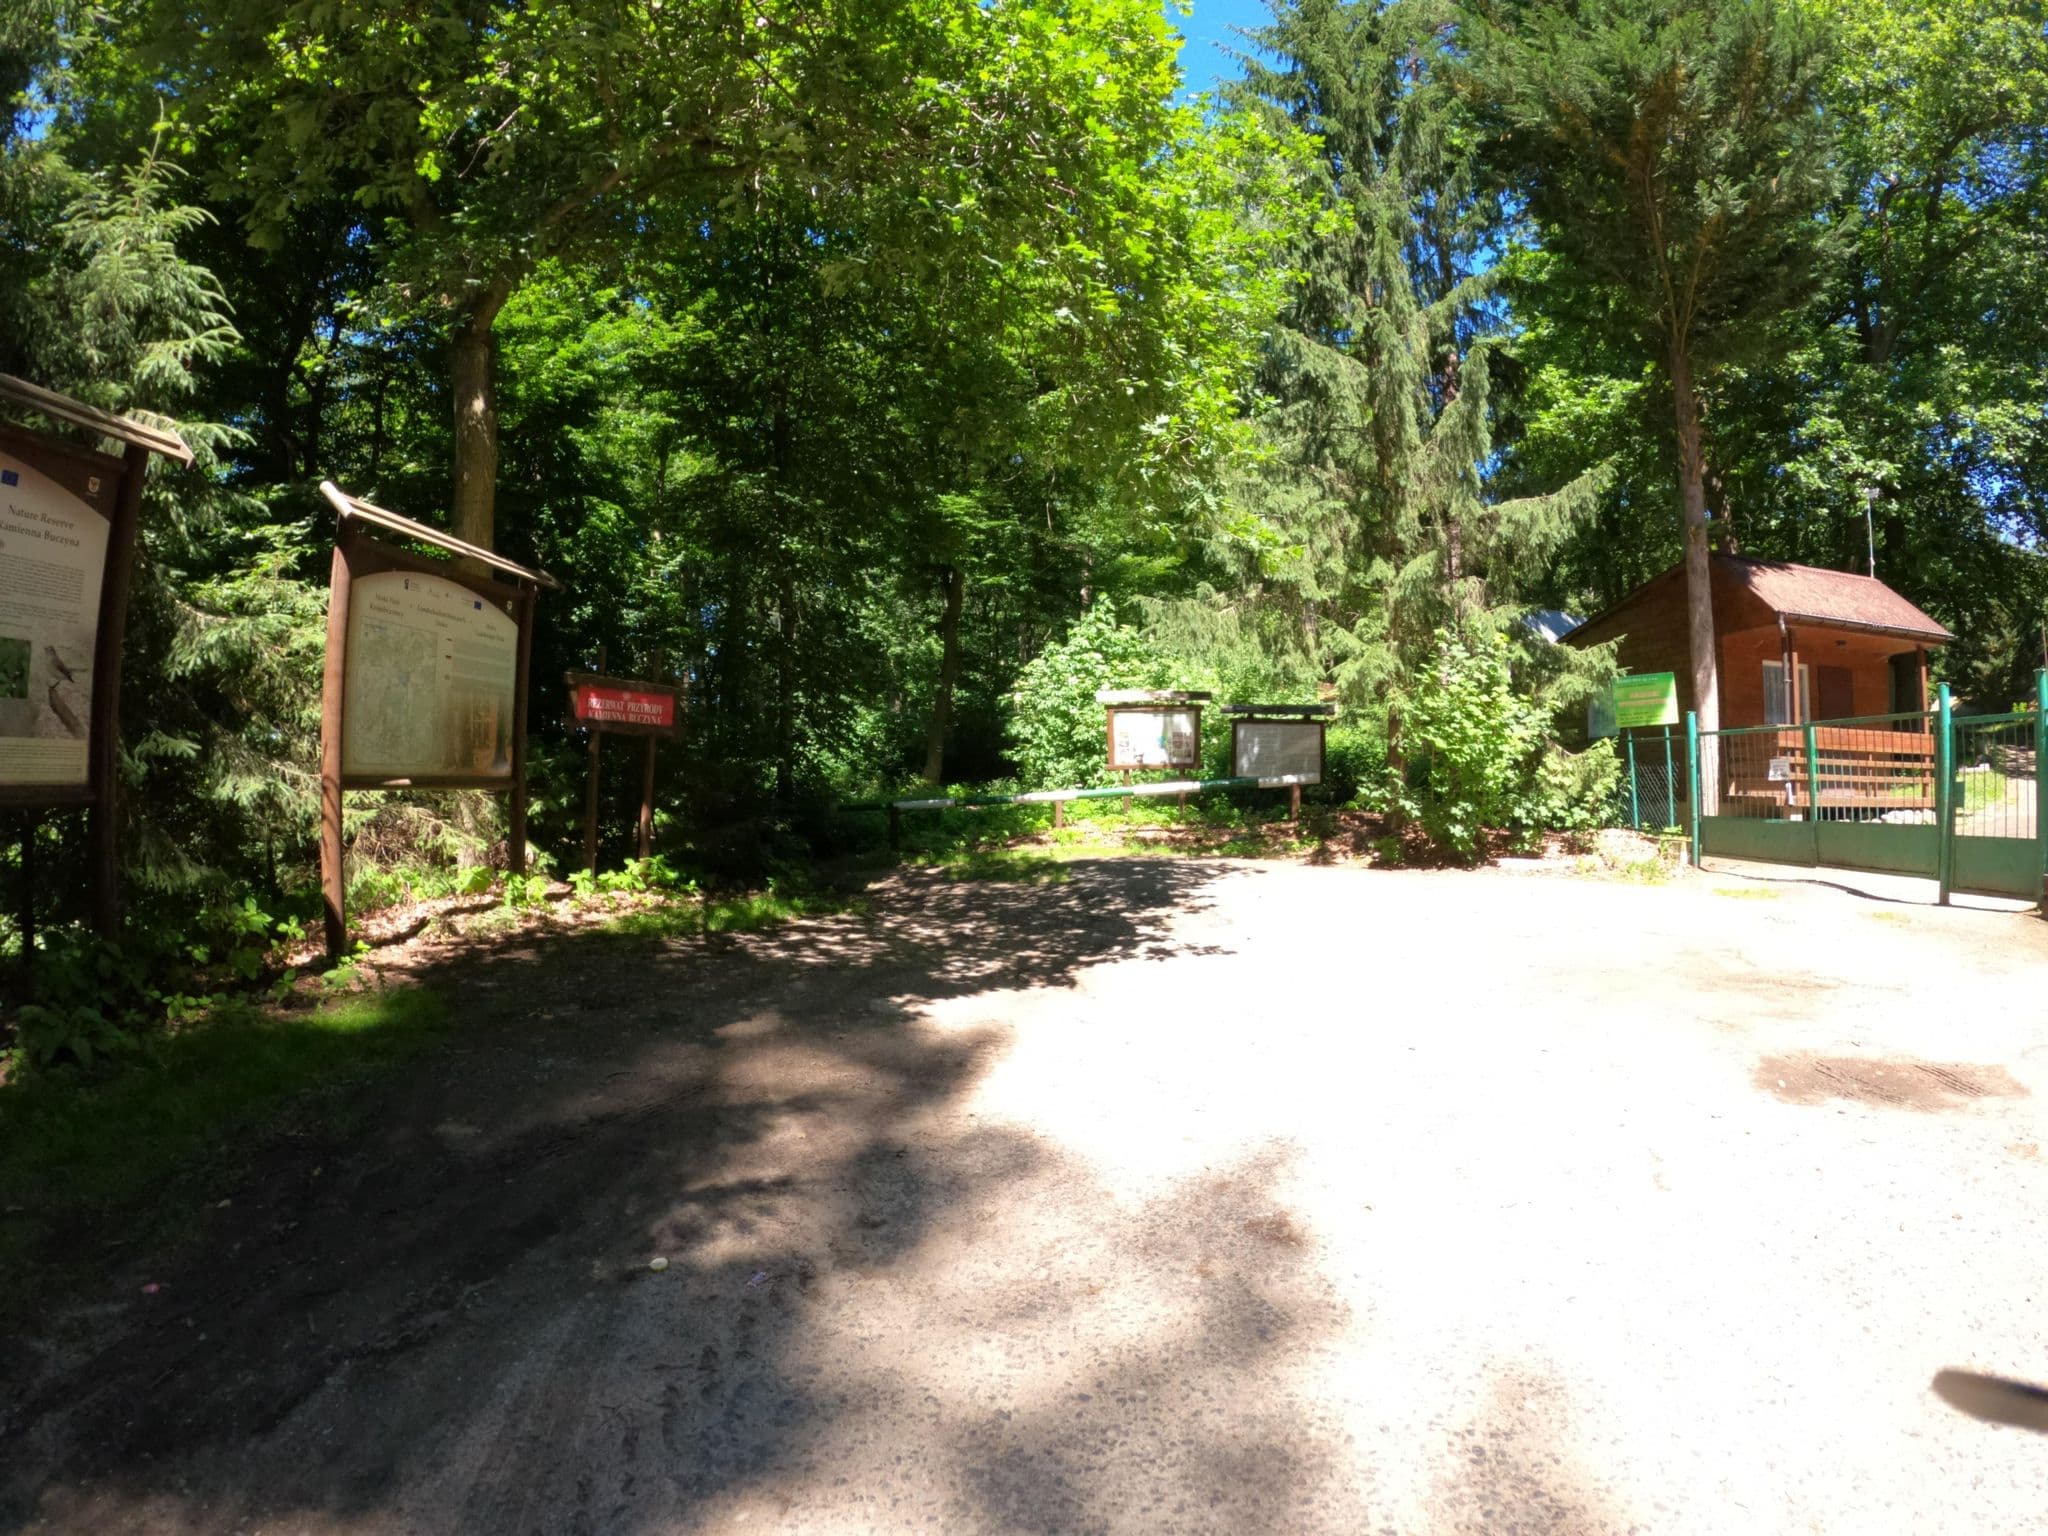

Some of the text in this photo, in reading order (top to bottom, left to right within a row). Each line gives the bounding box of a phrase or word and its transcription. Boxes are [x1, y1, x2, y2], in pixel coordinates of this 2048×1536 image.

[8, 504, 74, 529] Nature Reserve
[44, 529, 80, 547] Buczyna
[627, 702, 663, 715] PRZYRODY
